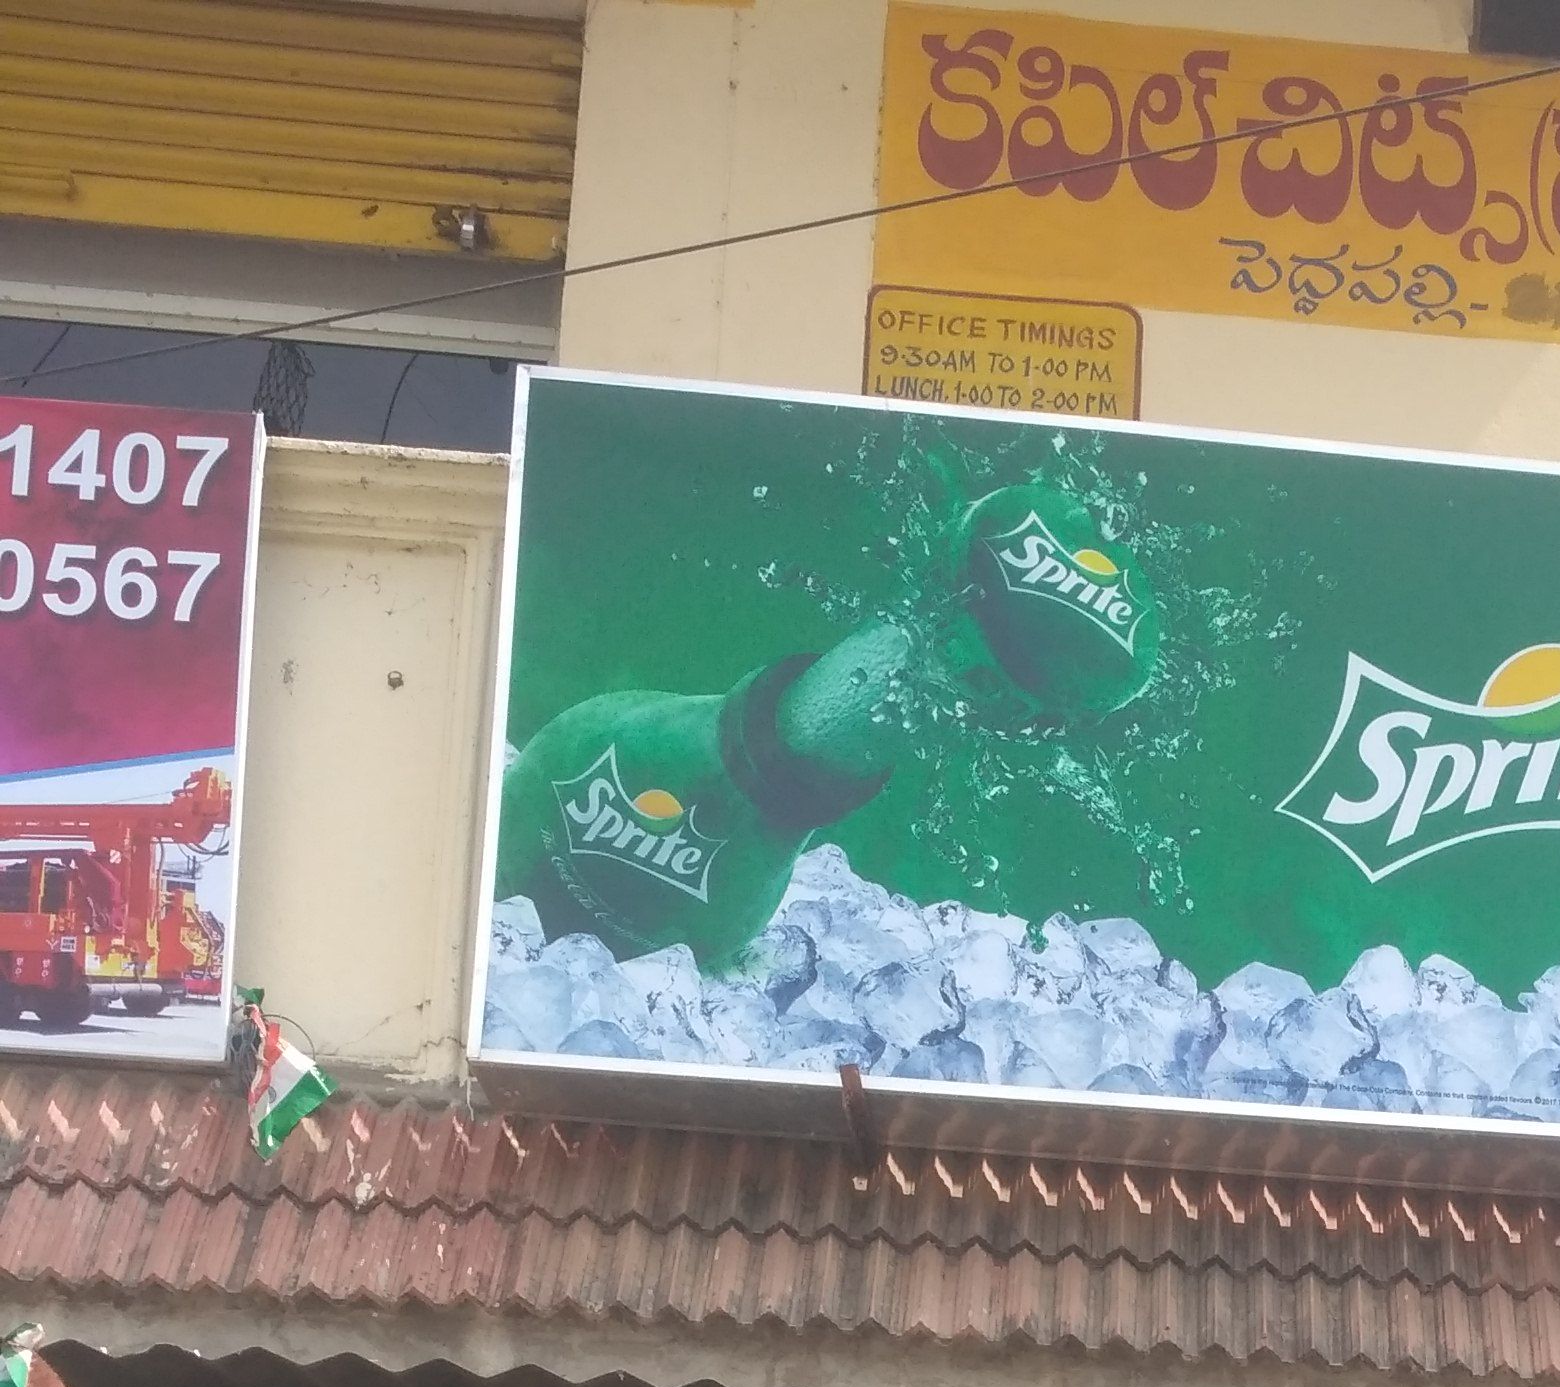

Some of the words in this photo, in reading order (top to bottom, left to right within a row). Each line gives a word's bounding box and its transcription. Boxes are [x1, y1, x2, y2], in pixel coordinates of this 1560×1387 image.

[918, 29, 1230, 211] కపిల్
[877, 310, 987, 339] OFFICE
[996, 319, 1116, 351] TIMINGS
[989, 352, 1015, 374] TO
[1076, 360, 1112, 382] PM
[997, 386, 1021, 406] TO
[1086, 392, 1118, 415] PM
[999, 536, 1133, 626] Sprite
[566, 779, 705, 875] Sprite
